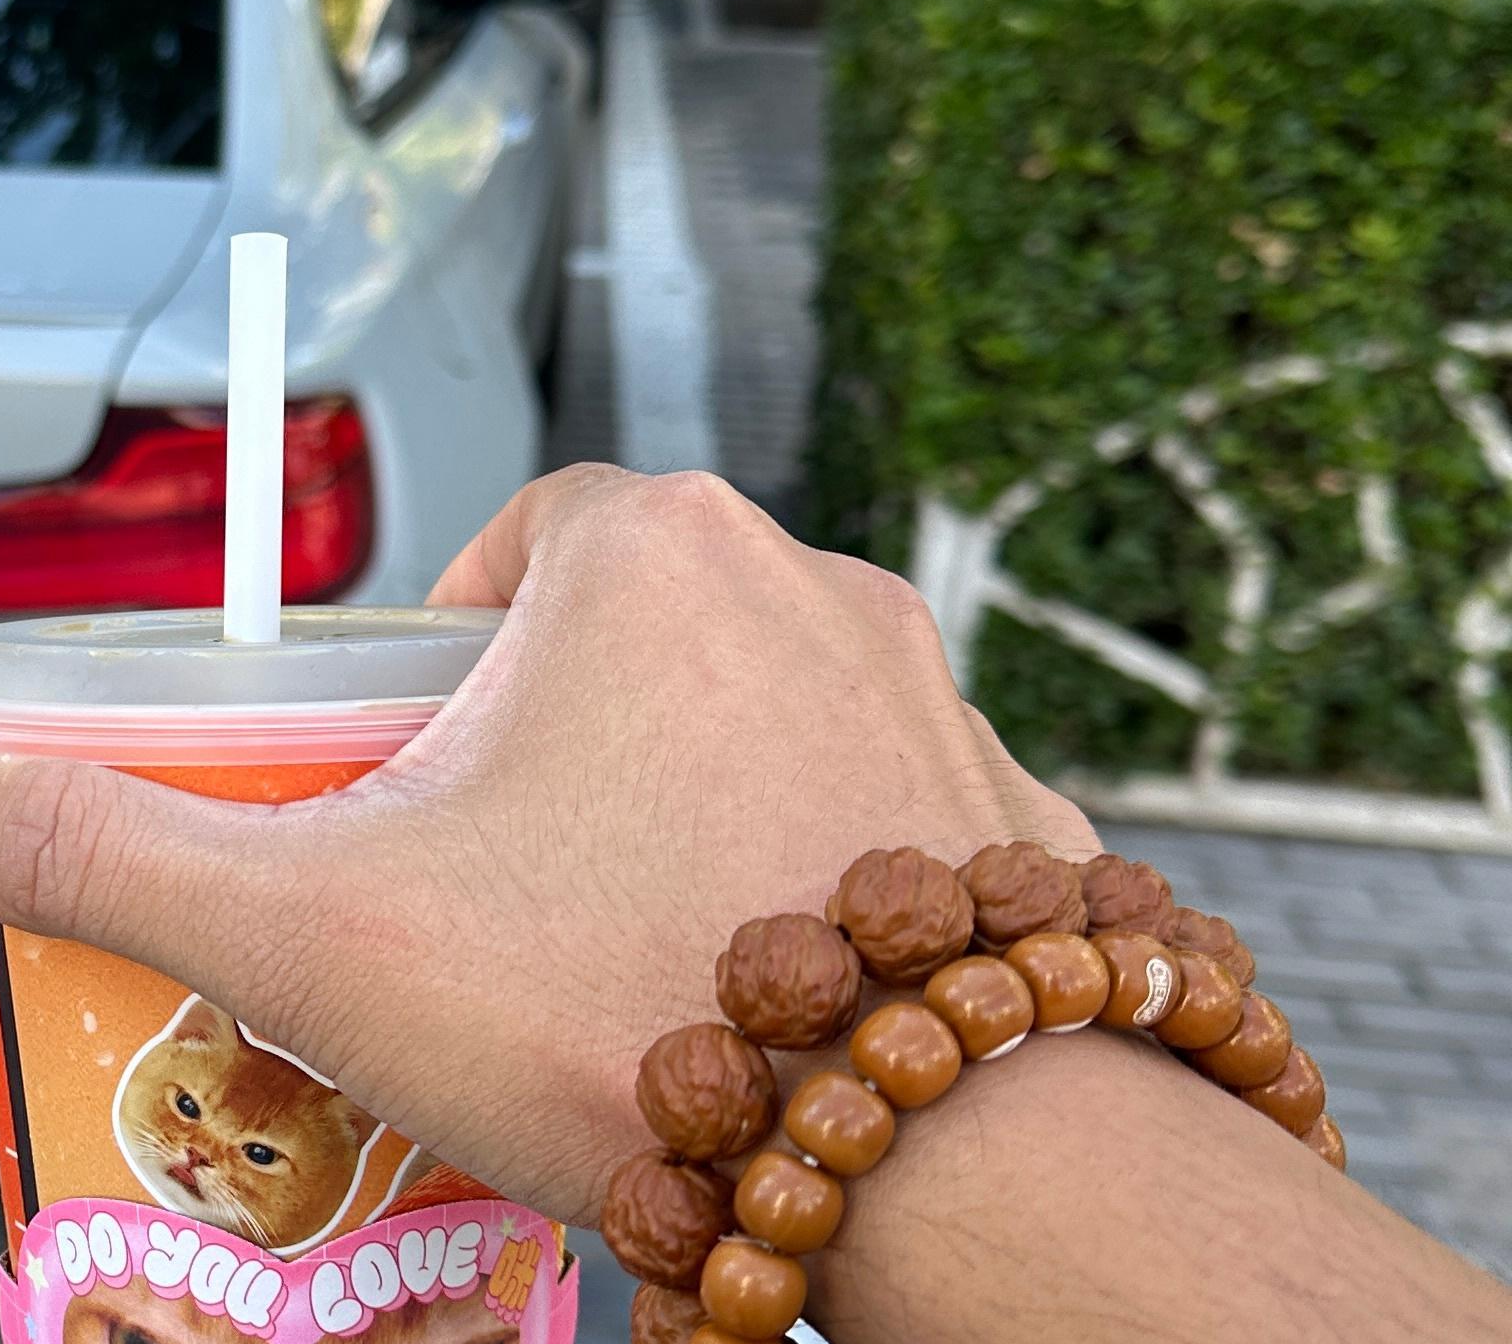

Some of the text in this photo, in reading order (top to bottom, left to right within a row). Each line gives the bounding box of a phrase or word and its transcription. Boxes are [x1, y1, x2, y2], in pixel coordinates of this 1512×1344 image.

[54, 1210, 132, 1292] DO
[141, 1219, 286, 1333] YOU
[308, 1219, 487, 1334] LOVE
